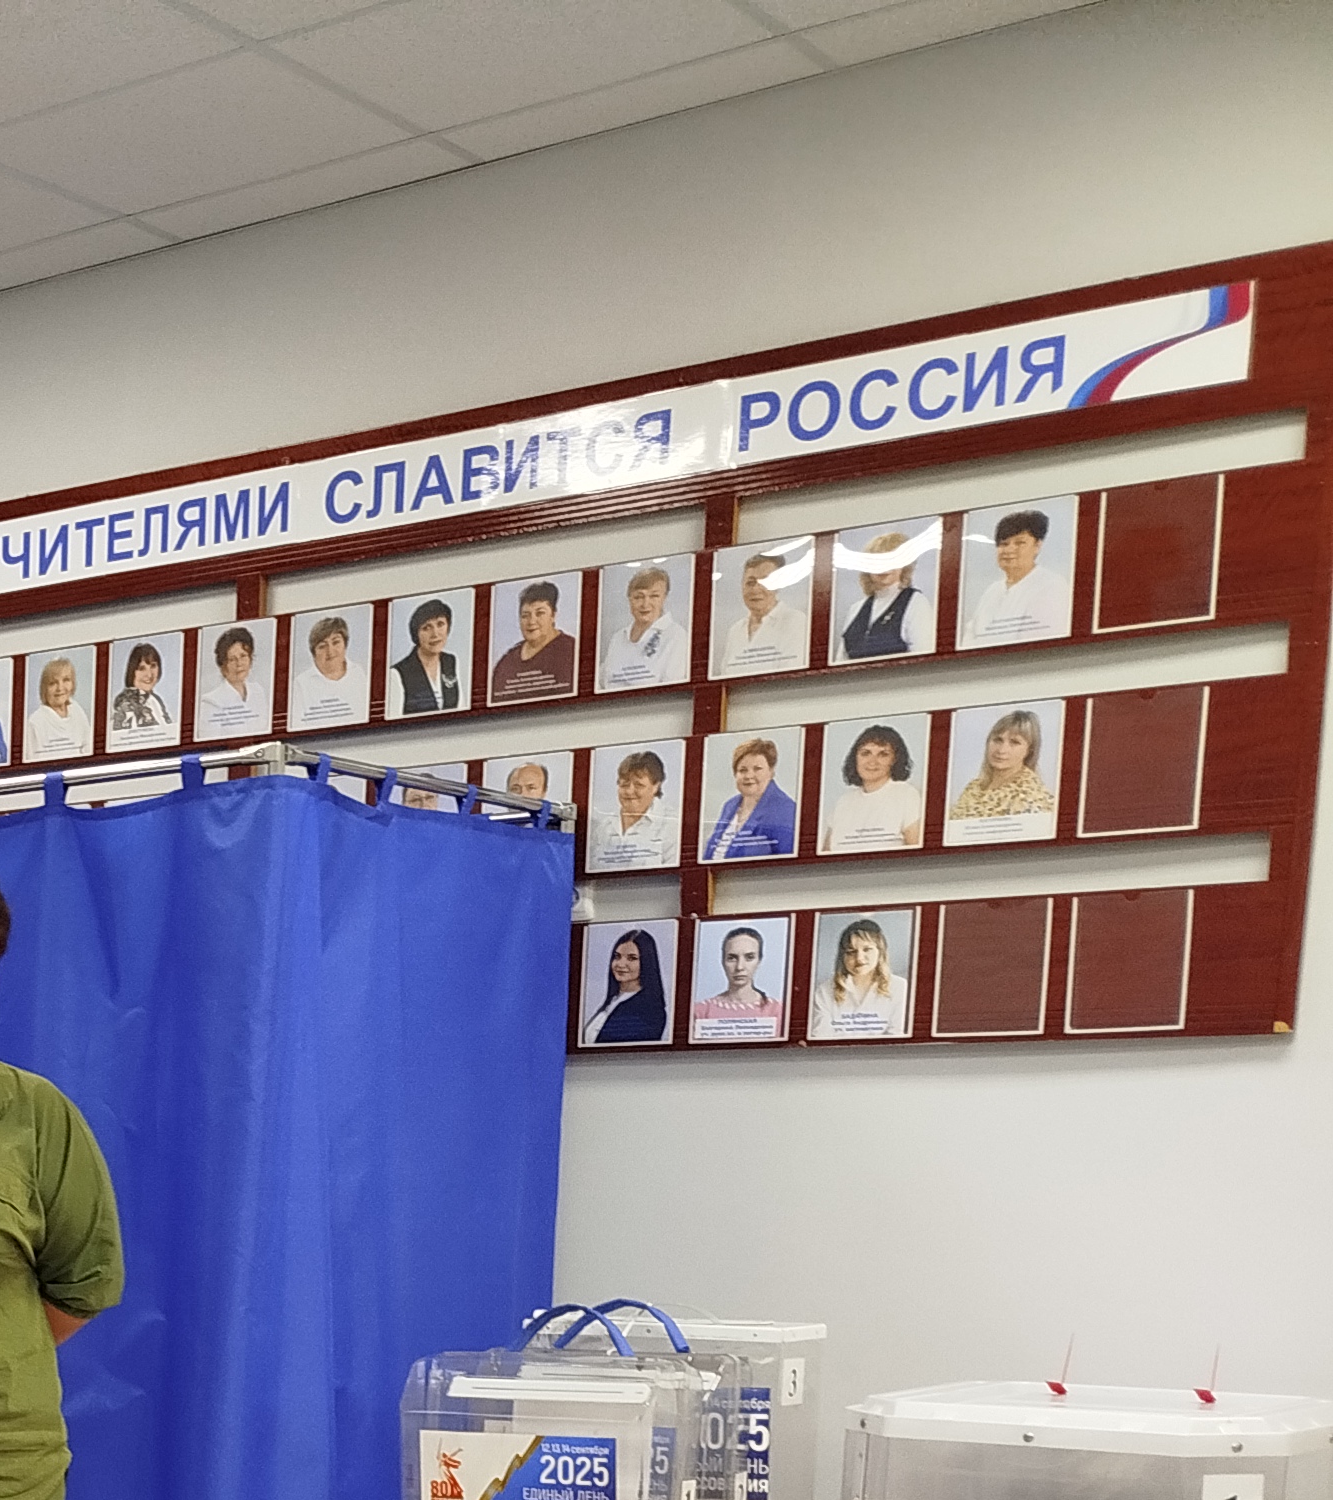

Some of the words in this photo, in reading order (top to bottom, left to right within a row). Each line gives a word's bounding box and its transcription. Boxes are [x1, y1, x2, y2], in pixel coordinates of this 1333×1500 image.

[324, 408, 673, 525] СЛАВИТСЯ
[738, 334, 1066, 452] РОССИЯ
[788, 1368, 798, 1398] 3
[539, 1454, 610, 1487] 2025
